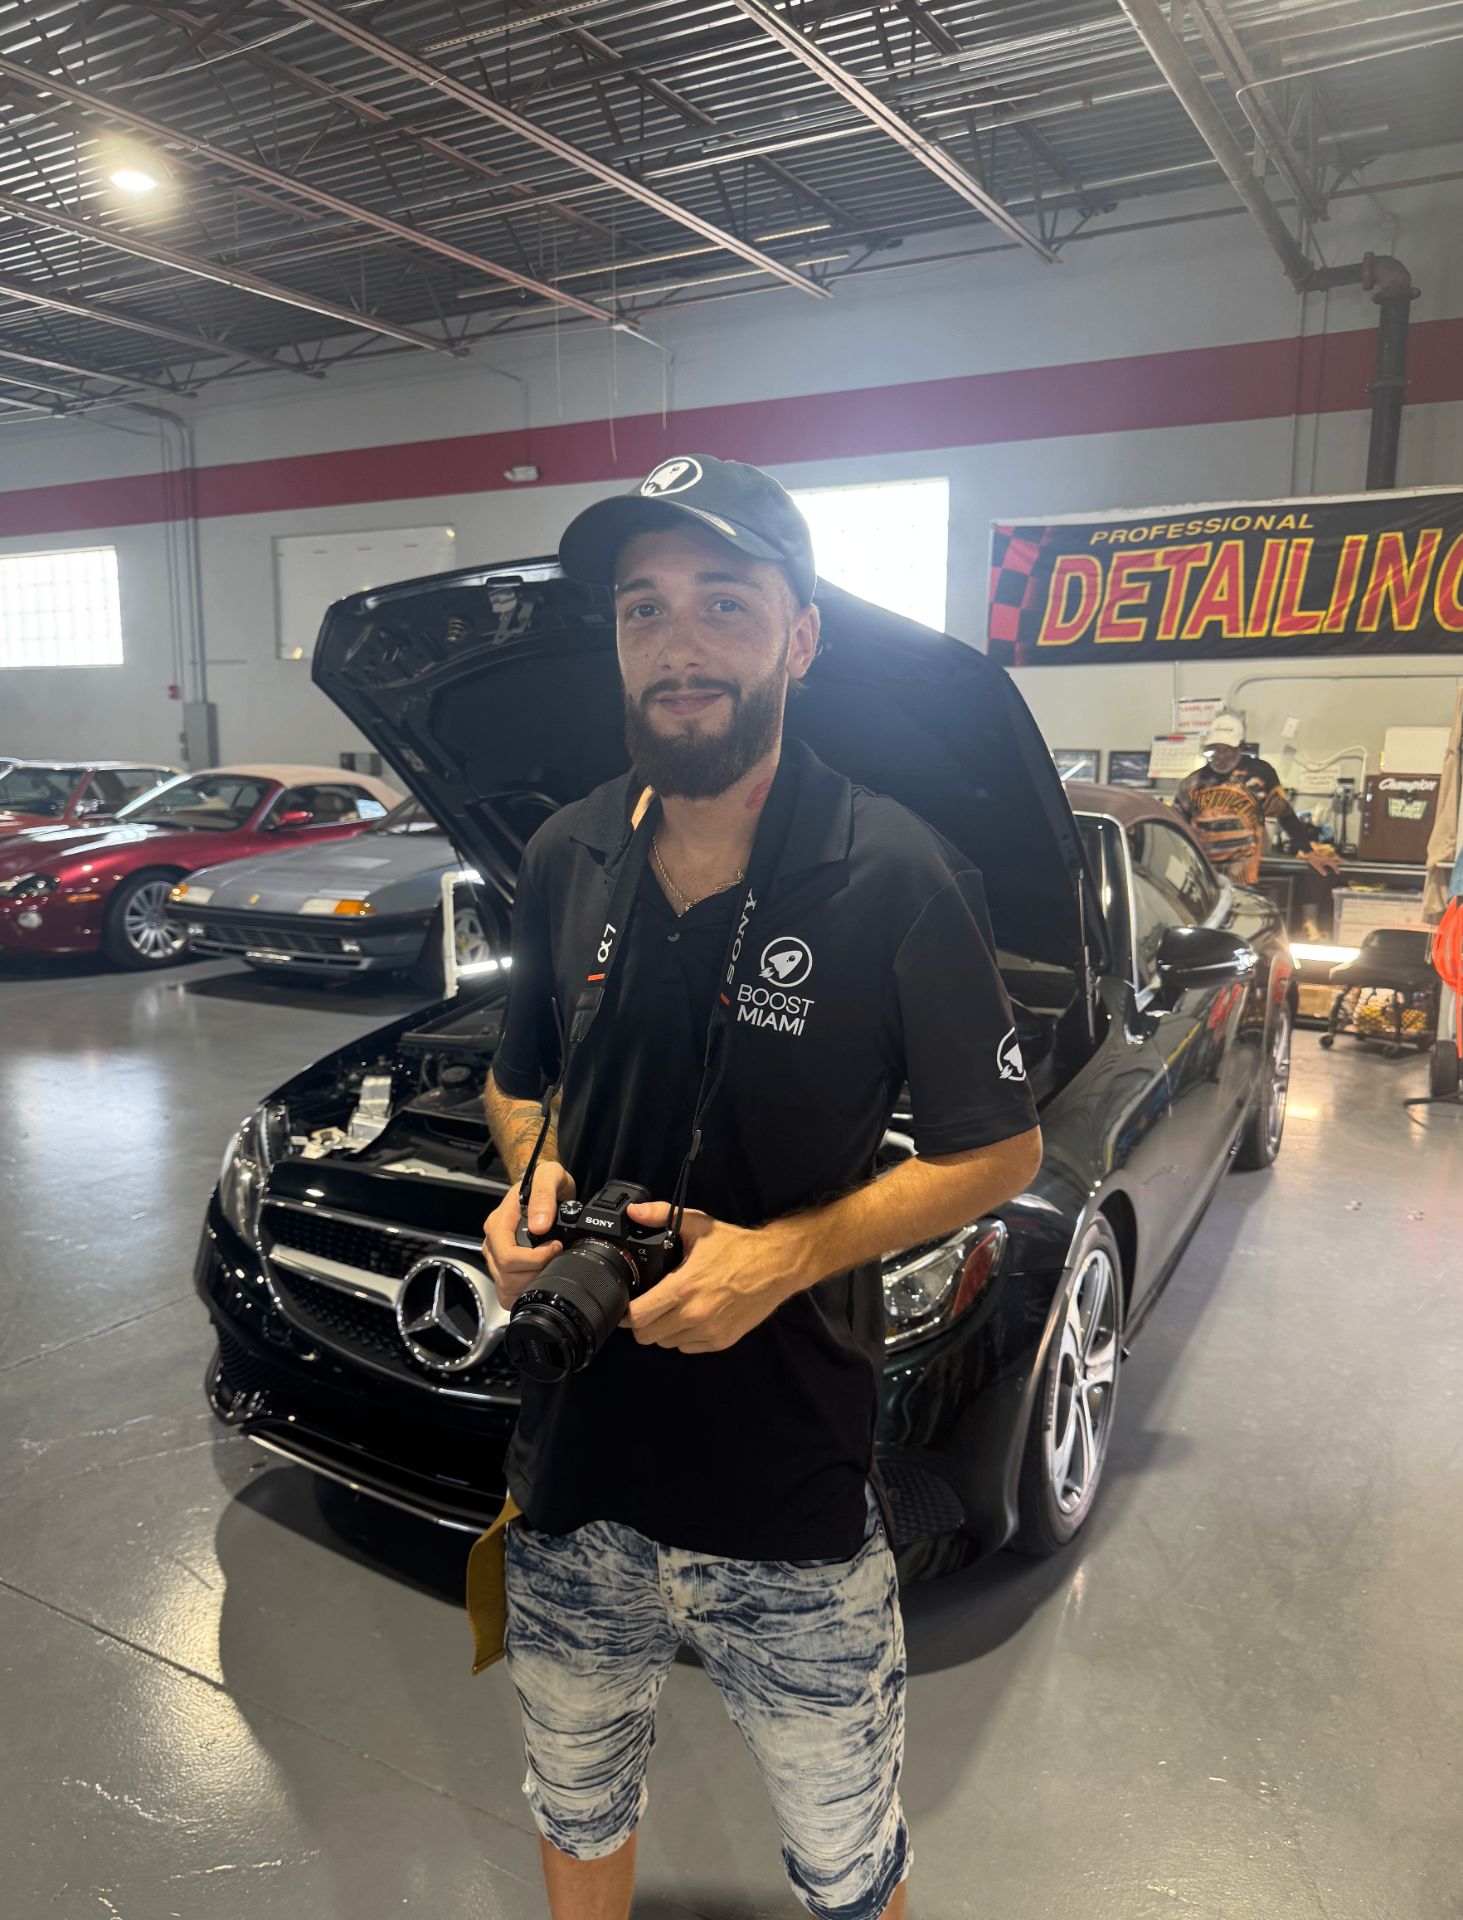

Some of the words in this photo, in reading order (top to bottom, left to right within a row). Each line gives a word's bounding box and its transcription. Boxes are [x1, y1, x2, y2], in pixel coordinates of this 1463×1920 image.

[1089, 513, 1316, 546] PROFESSIONAL
[1378, 778, 1438, 793] Champion
[726, 888, 757, 985] SONY
[737, 983, 815, 1017] BOOST
[736, 1005, 806, 1036] MIAMI
[585, 1216, 615, 1229] SONY
[530, 1338, 542, 1364] SONY
